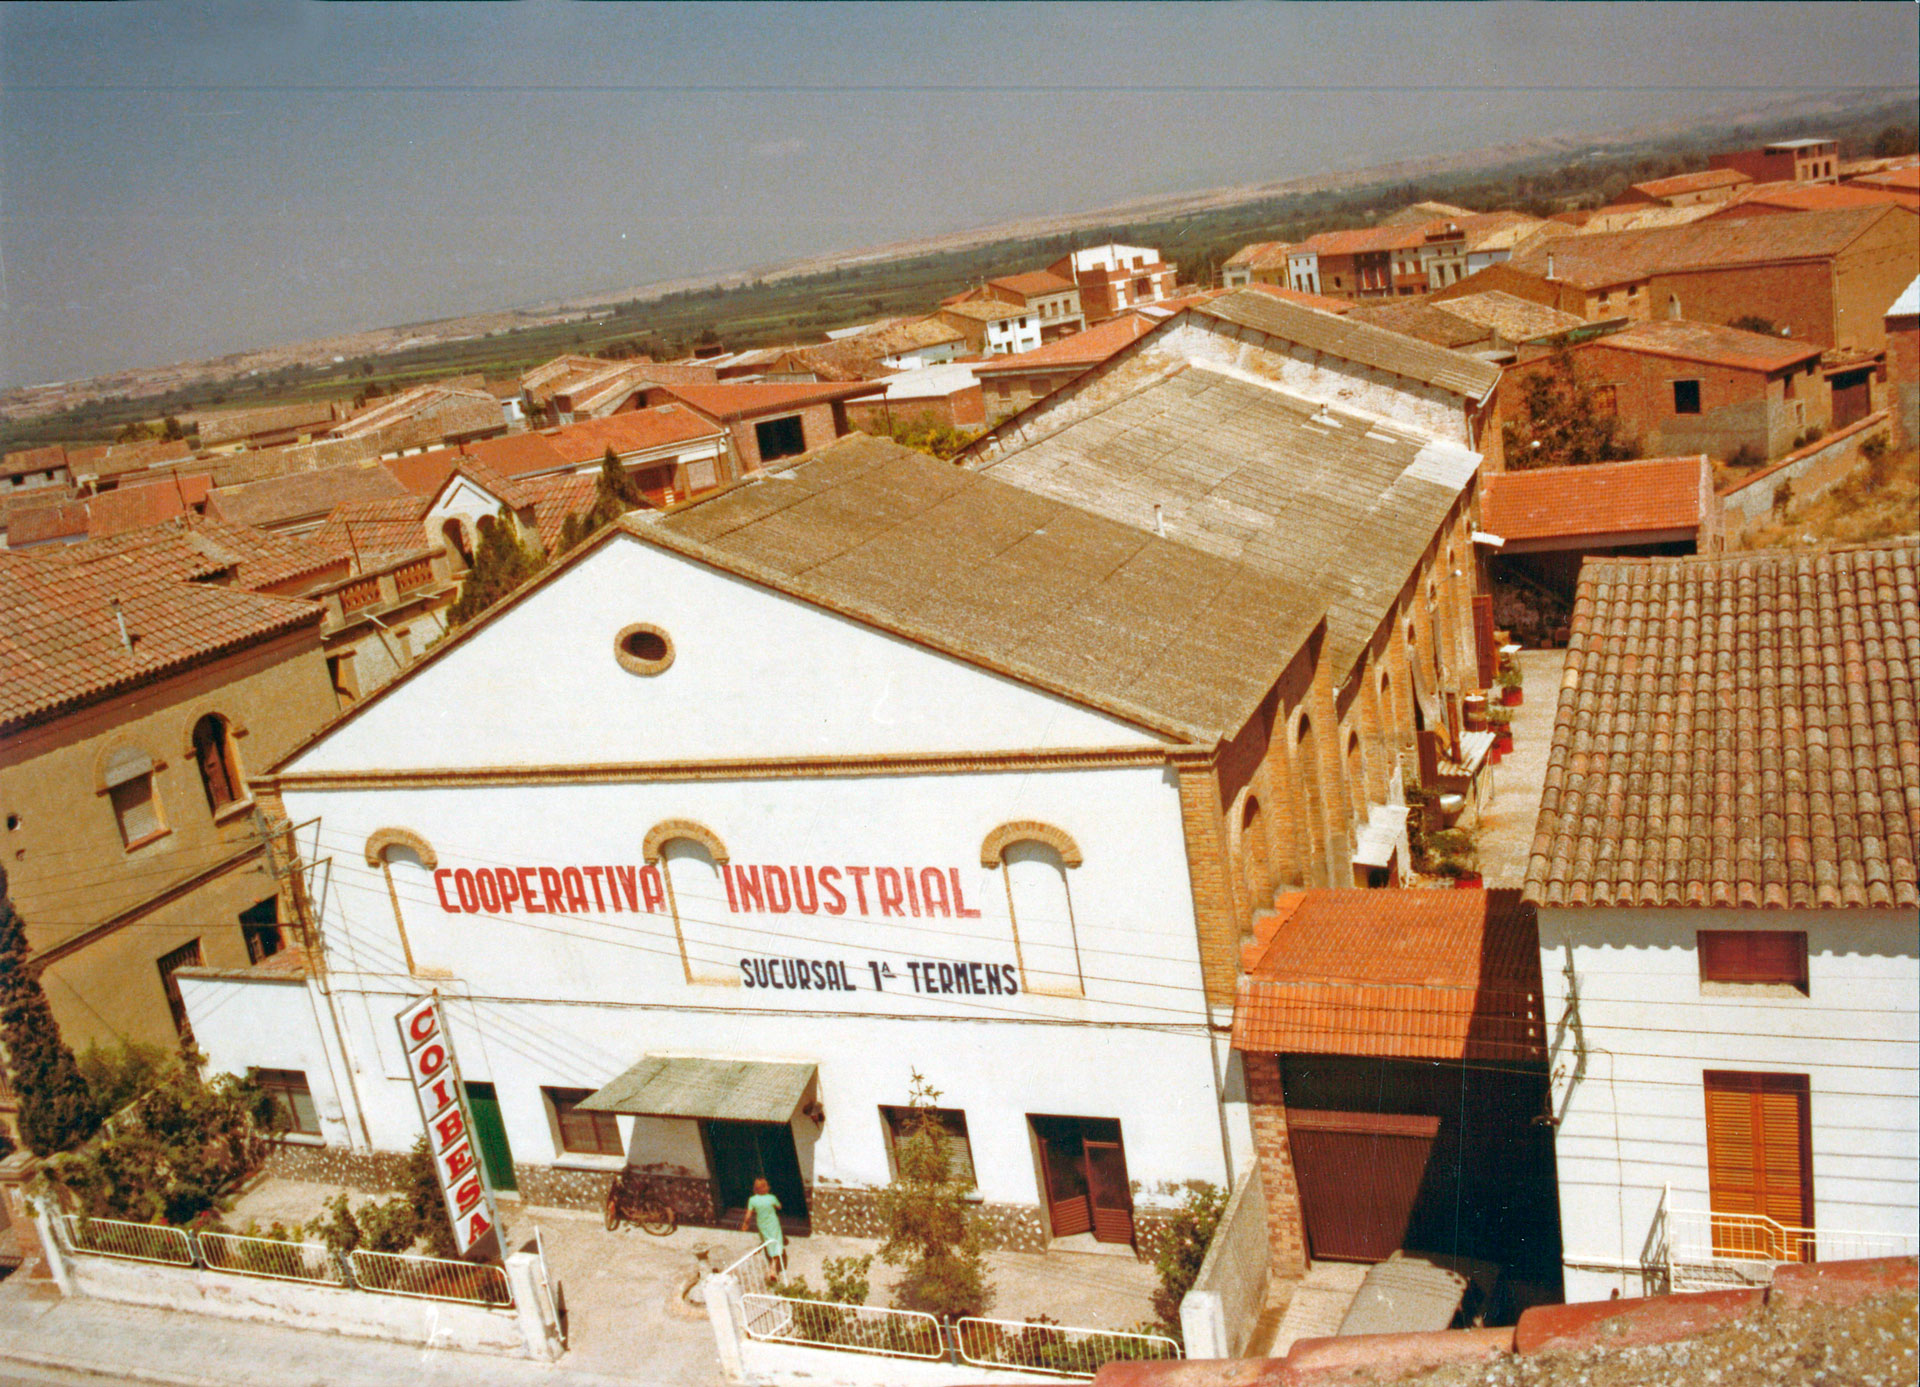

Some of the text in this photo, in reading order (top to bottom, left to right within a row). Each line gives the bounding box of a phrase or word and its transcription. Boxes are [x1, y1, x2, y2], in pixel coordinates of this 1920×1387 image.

[433, 864, 981, 919] COOPERATIVA INDUSTRIAL
[740, 958, 857, 992] SUCURSAL
[907, 961, 1019, 996] TERMENS
[410, 1006, 491, 1246] COIBESA
